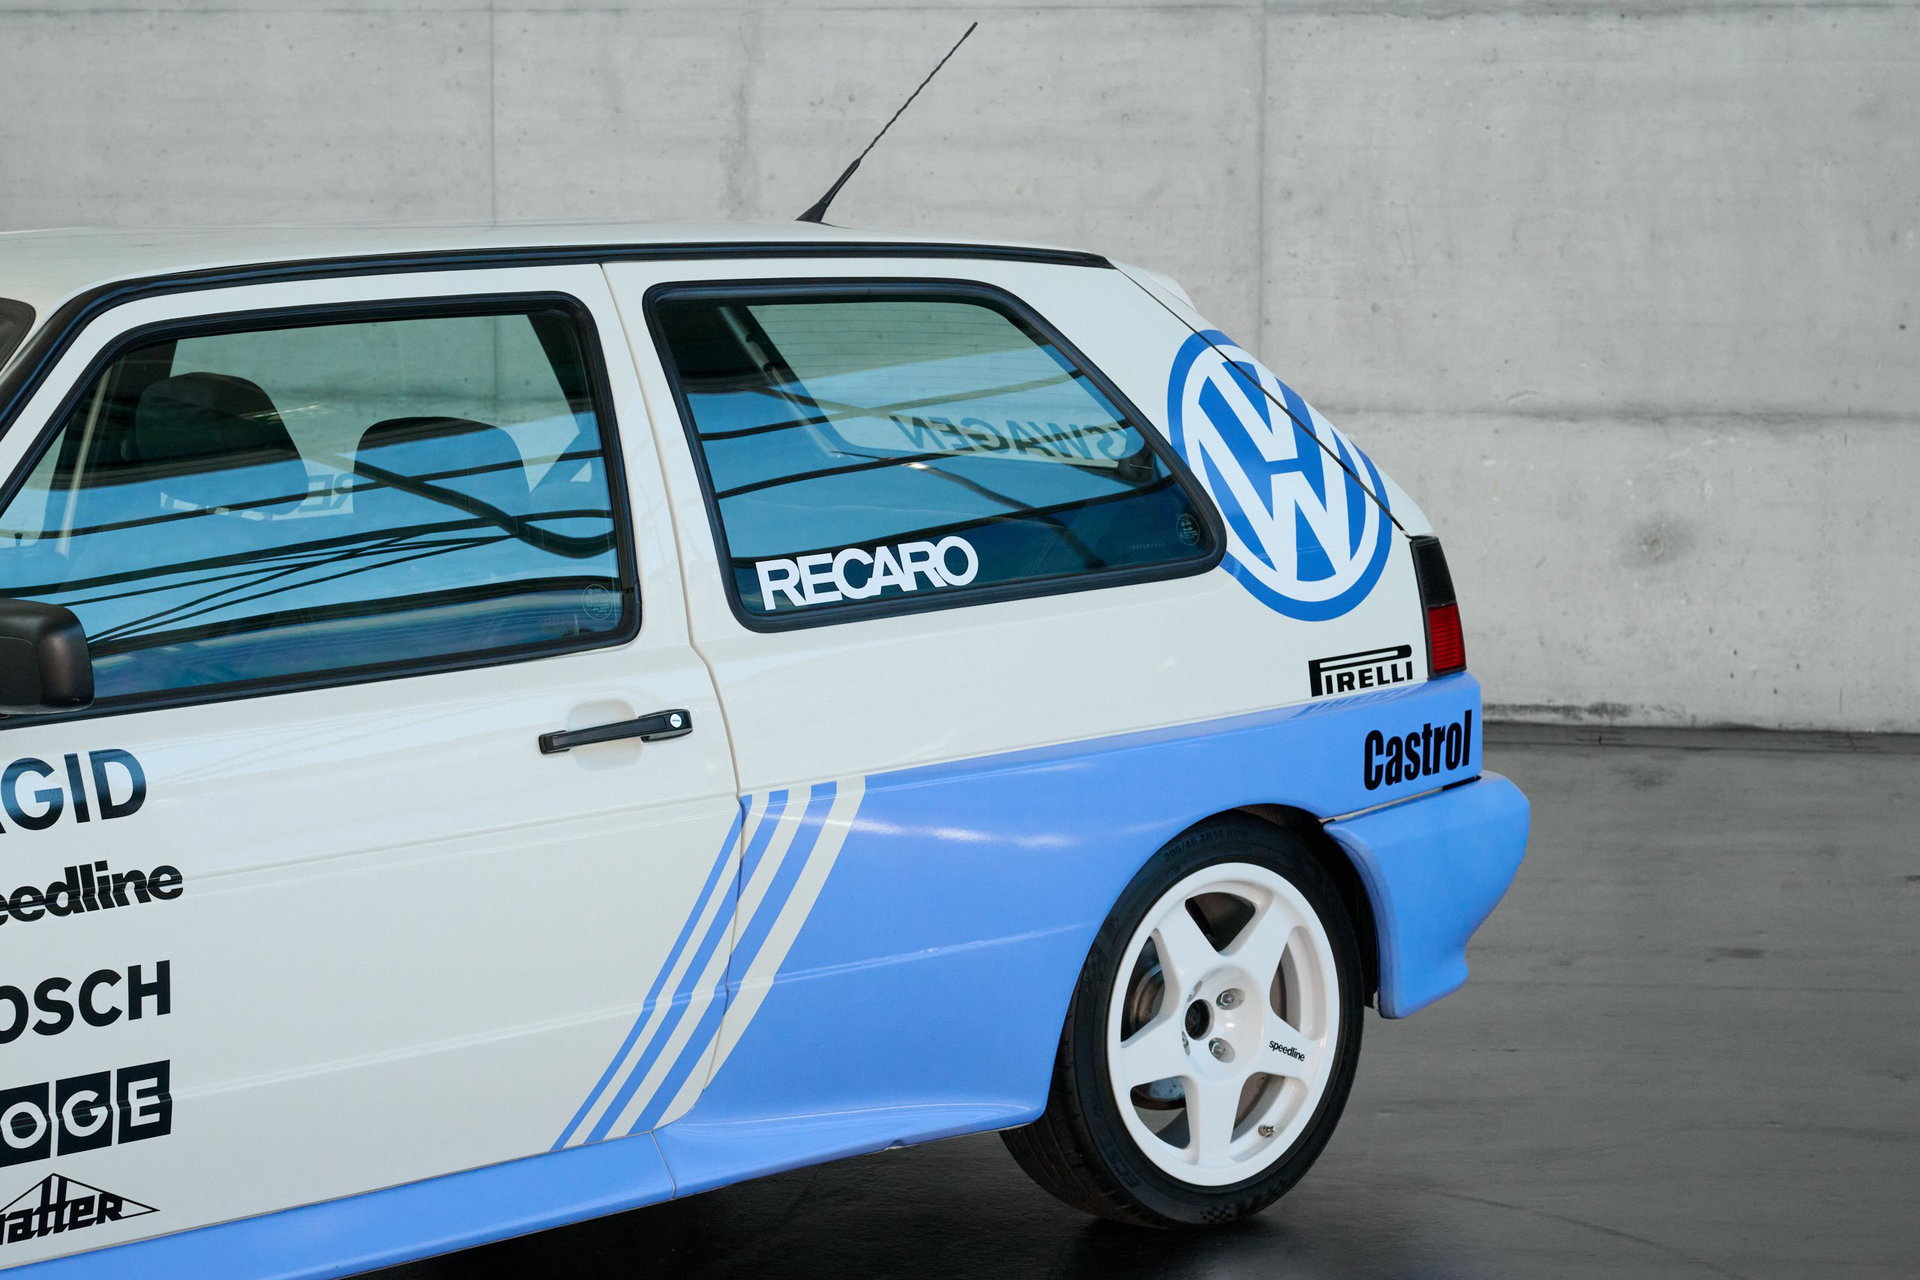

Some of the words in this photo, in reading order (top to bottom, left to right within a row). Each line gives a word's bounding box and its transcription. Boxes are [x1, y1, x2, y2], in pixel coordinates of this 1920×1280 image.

[755, 535, 979, 611] RECARO
[1308, 644, 1413, 697] PIRELLI
[1364, 709, 1472, 791] Castrol
[0, 748, 147, 834] GID
[0, 860, 184, 926] edline
[1268, 1040, 1306, 1062] speedline
